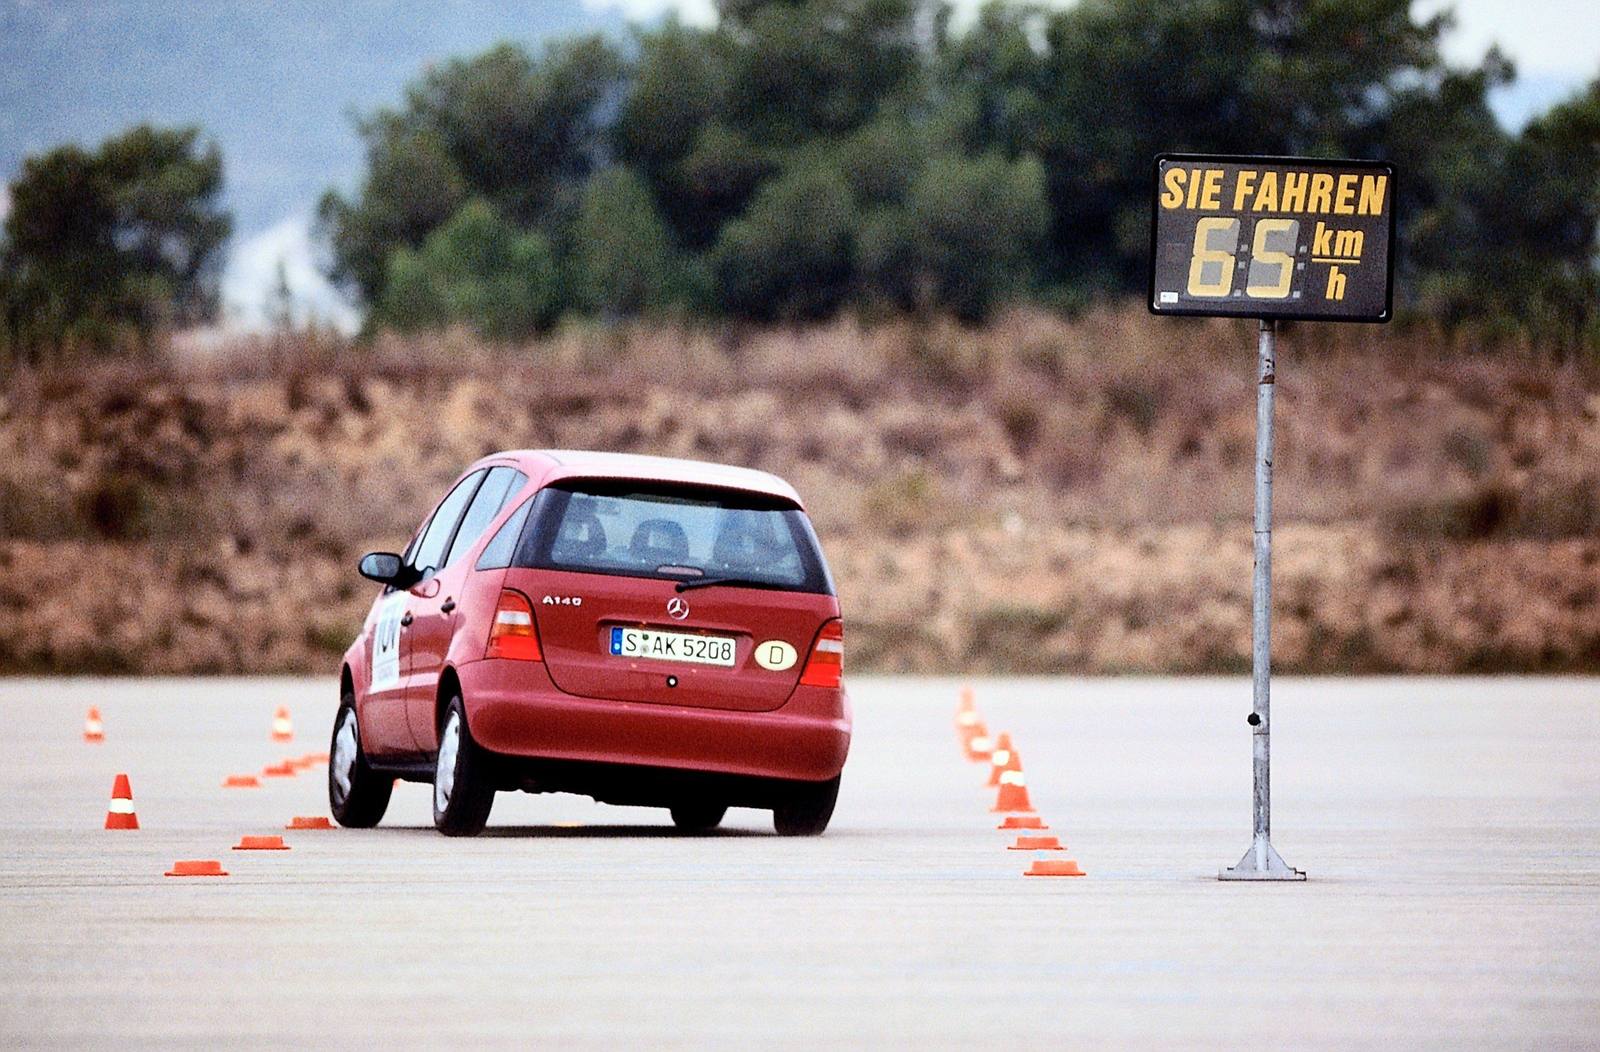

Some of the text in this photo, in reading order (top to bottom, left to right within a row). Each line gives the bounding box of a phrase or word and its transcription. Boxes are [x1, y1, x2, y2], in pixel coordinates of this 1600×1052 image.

[1161, 167, 1387, 216] SIE FAHREN
[1312, 221, 1364, 257] km
[1187, 217, 1297, 298] 65
[1326, 265, 1347, 301] h
[542, 595, 582, 606] A140
[625, 633, 638, 652] S
[652, 636, 677, 656] AK
[683, 638, 731, 661] 5208
[769, 645, 784, 665] D
